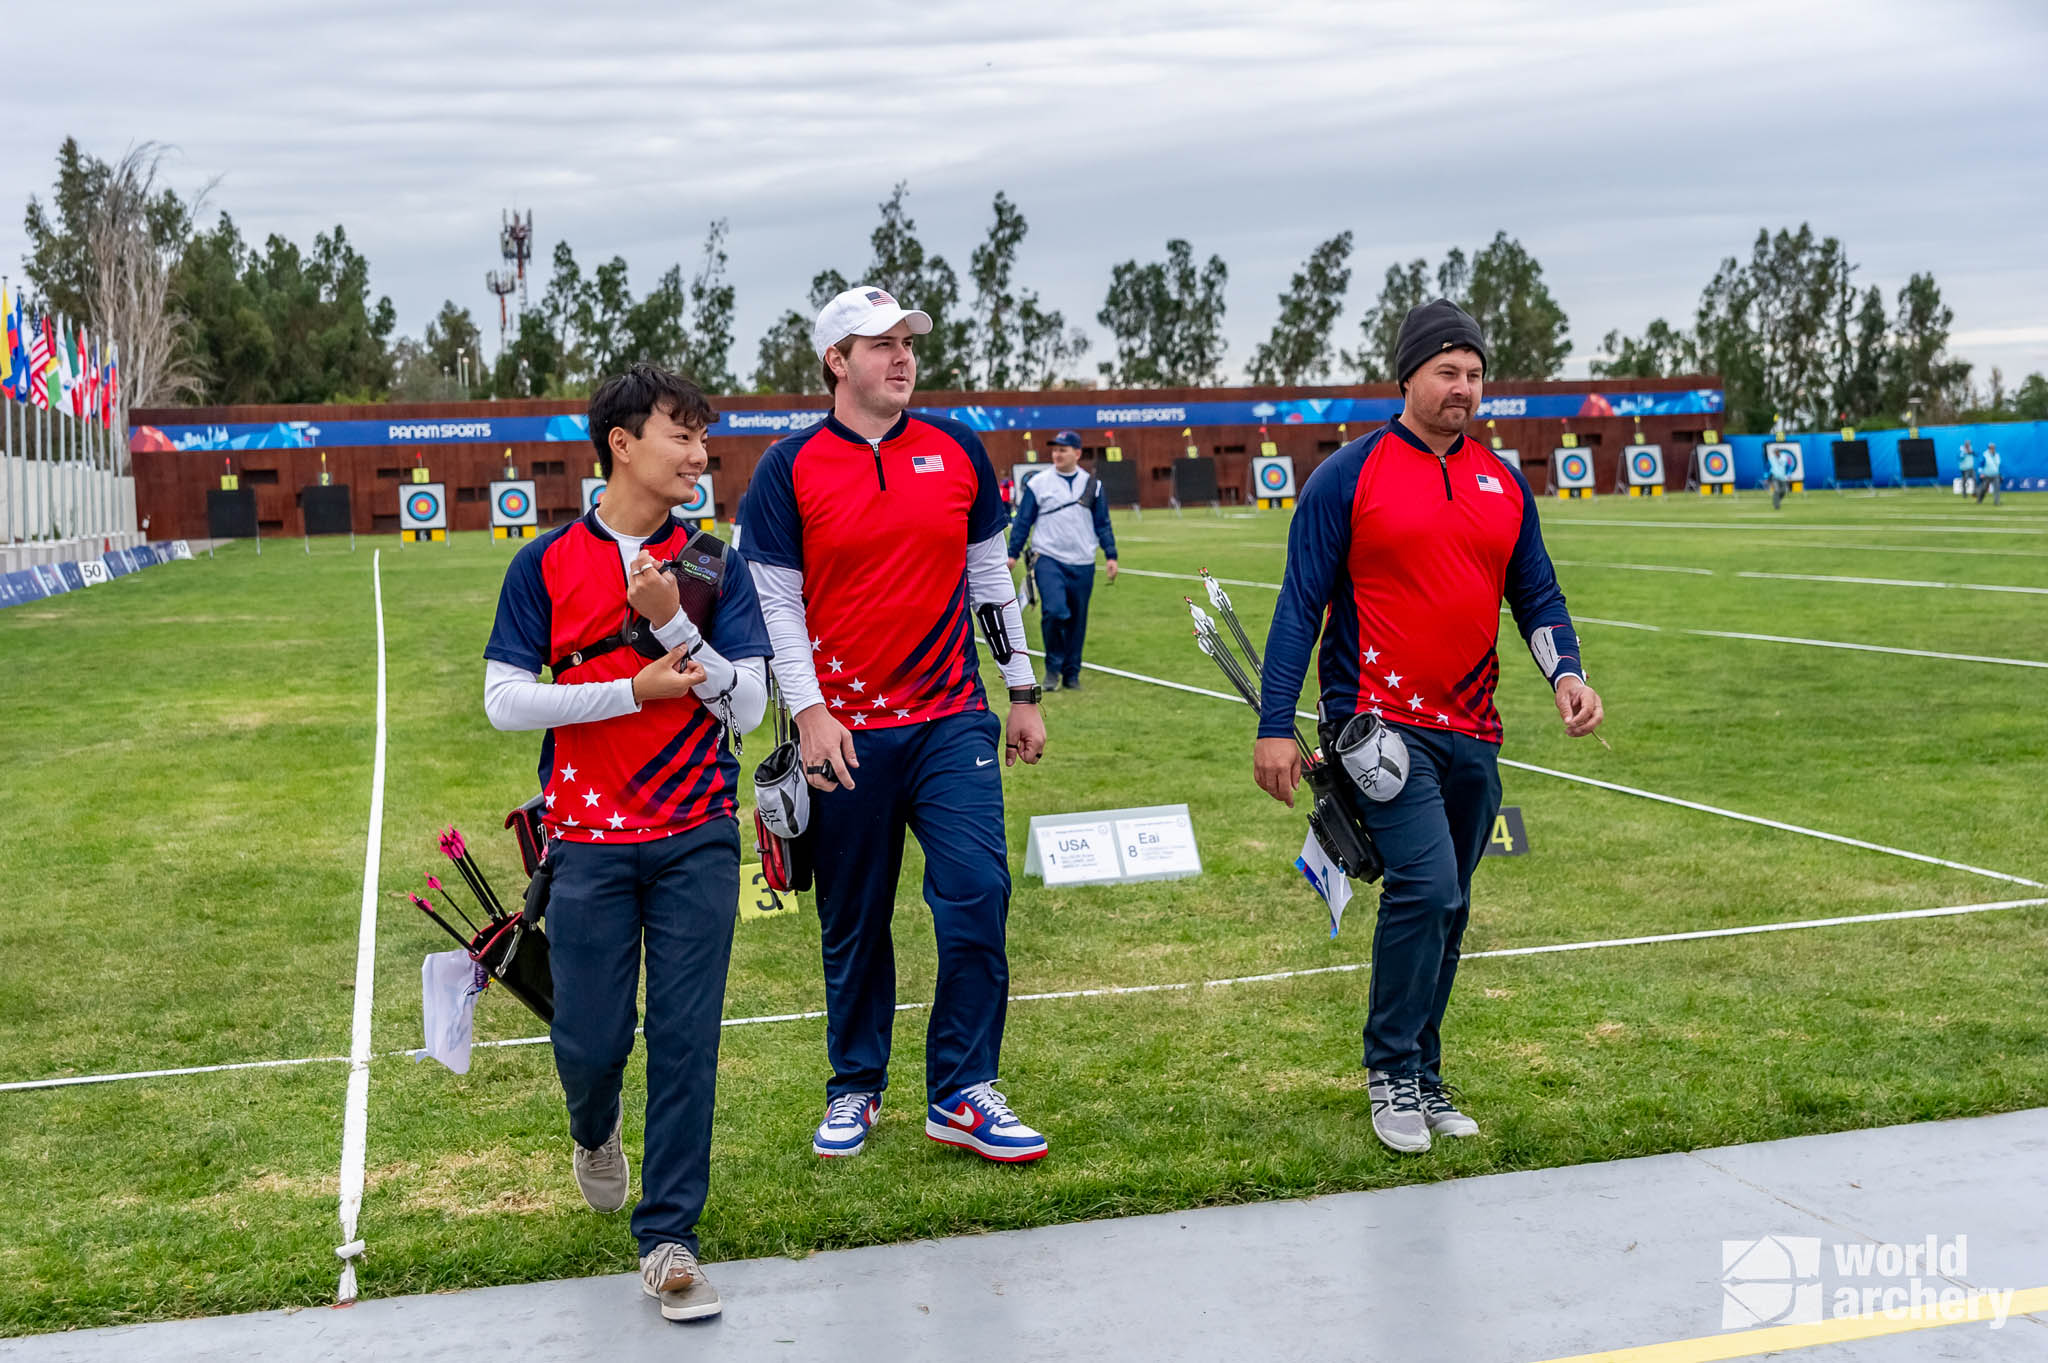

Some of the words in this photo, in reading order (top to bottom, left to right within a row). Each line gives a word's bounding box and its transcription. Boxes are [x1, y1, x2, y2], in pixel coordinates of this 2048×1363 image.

[728, 413, 790, 431] Santiago
[84, 564, 101, 578] 50
[1491, 814, 1513, 852] 4
[1058, 838, 1091, 852] USA
[1128, 844, 1138, 858] 8
[1048, 853, 1056, 865] 1
[751, 872, 777, 912] 3
